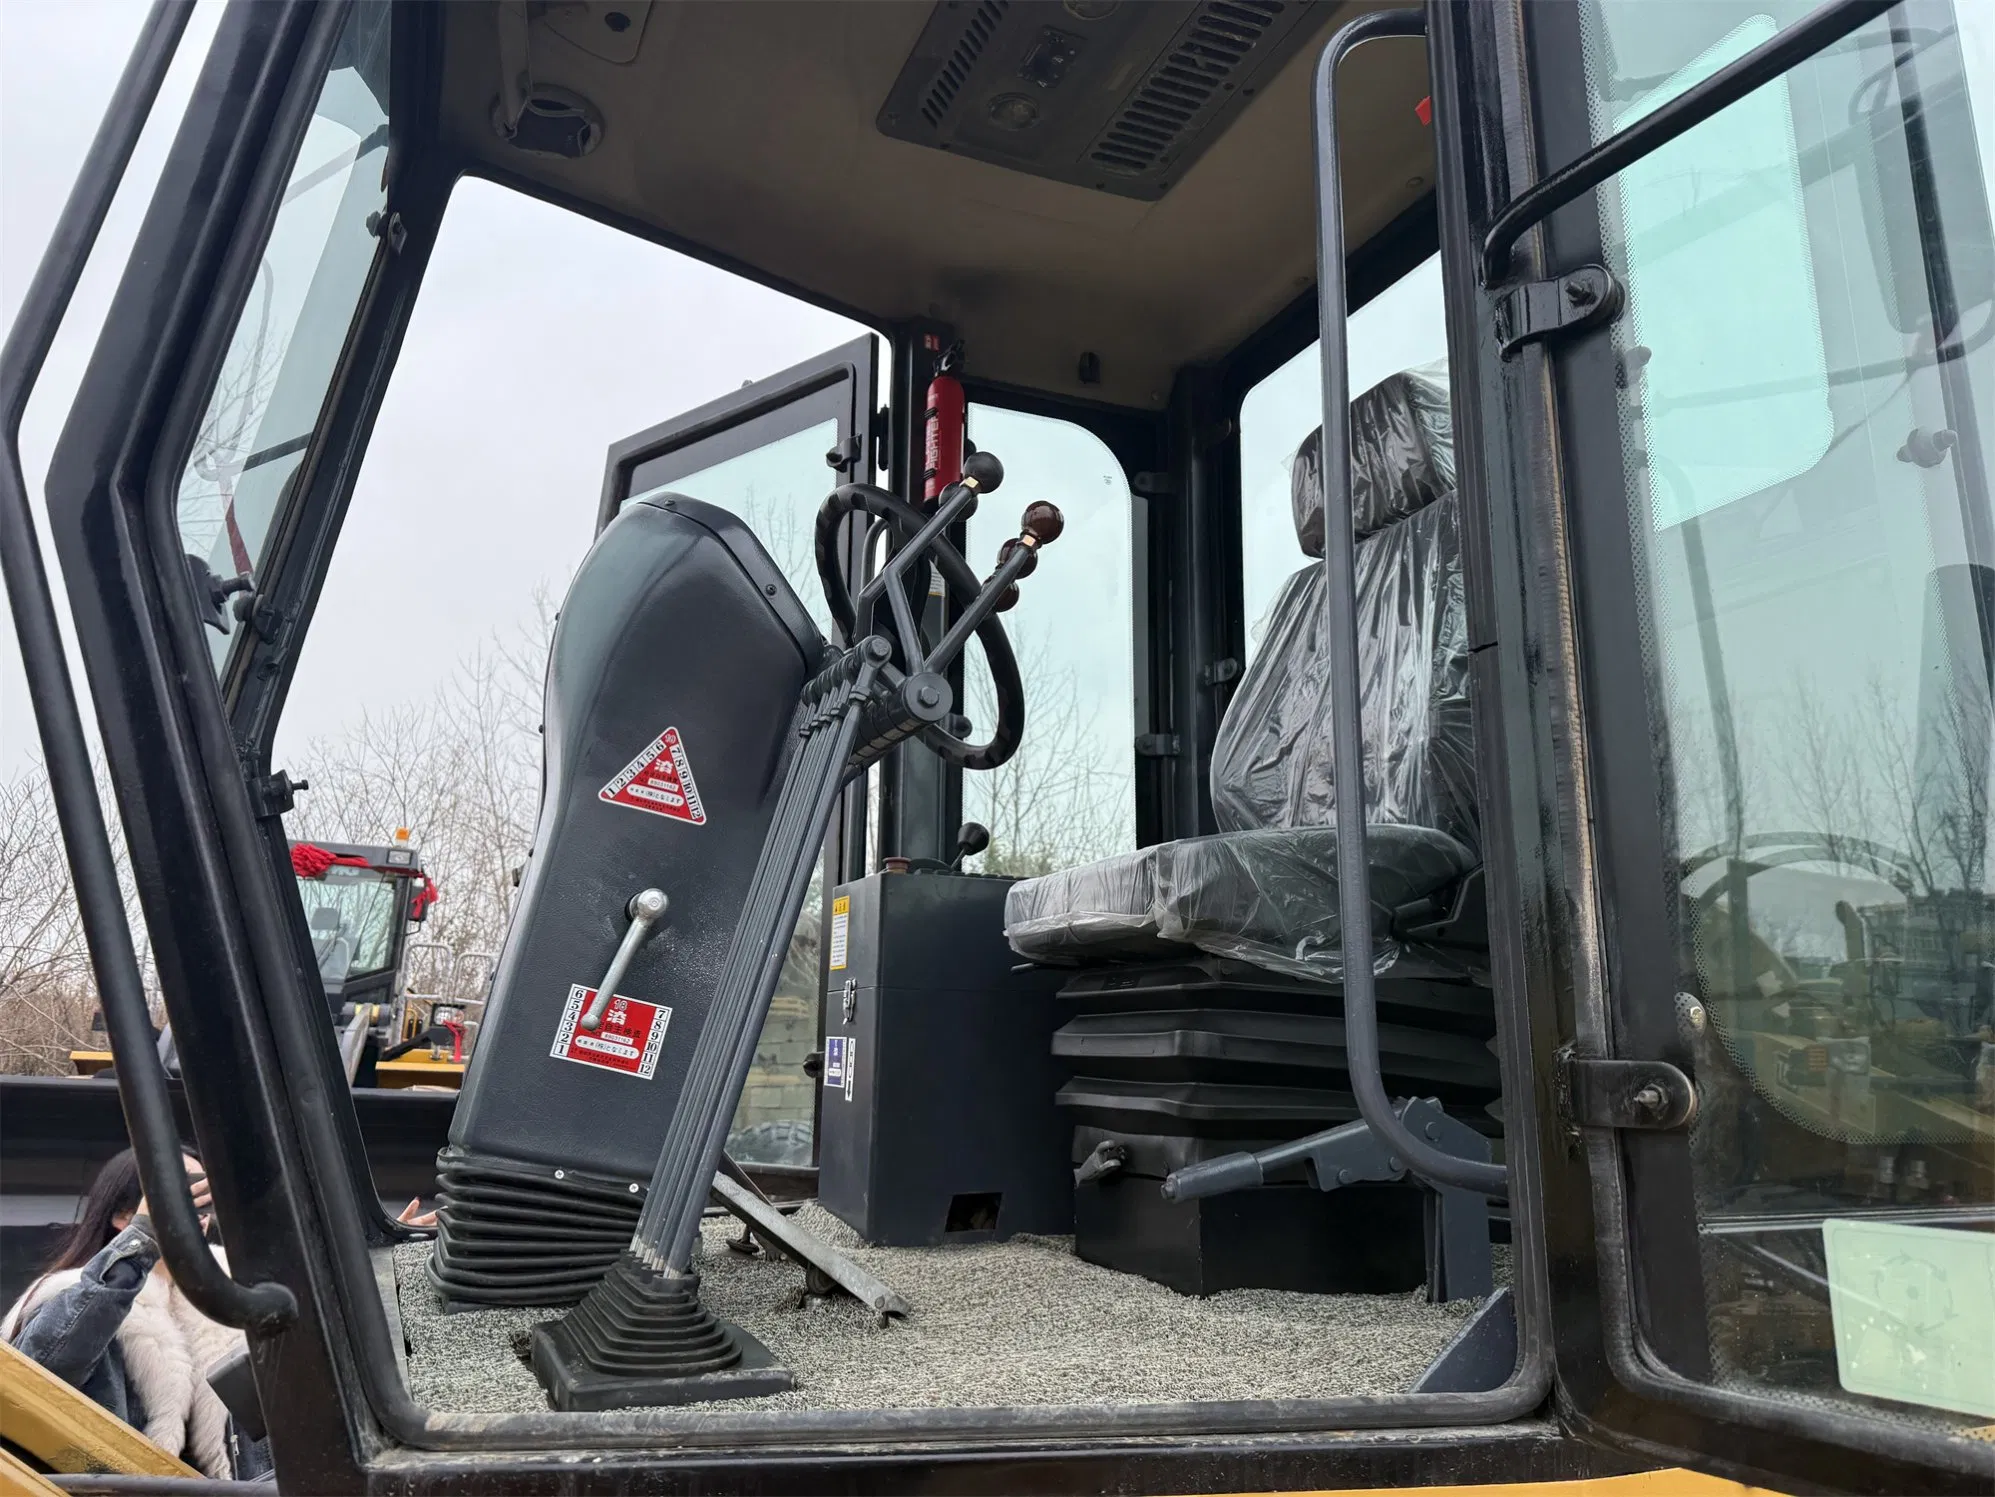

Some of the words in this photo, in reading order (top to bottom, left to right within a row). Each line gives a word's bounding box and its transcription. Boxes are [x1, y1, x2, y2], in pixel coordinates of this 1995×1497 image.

[675, 759, 684, 767] 8
[608, 787, 616, 796] 1
[617, 778, 627, 787] 2
[627, 769, 636, 778] 3
[636, 761, 645, 770] 4
[646, 751, 655, 761] 5
[655, 742, 665, 751] 6
[680, 771, 689, 779] 9
[683, 782, 694, 794] 10
[687, 795, 698, 805] 11
[691, 808, 702, 818] 12
[575, 990, 584, 999] 6
[571, 1001, 580, 1010] 5
[568, 1011, 576, 1020] 4
[658, 1010, 667, 1019] 7
[564, 1022, 573, 1031] 3
[654, 1021, 662, 1030] 8
[561, 1033, 570, 1042] 2
[650, 1031, 659, 1041] 9
[558, 1044, 565, 1054] 1
[646, 1042, 658, 1052] 10
[644, 1053, 654, 1063] 11
[640, 1064, 652, 1074] 12
